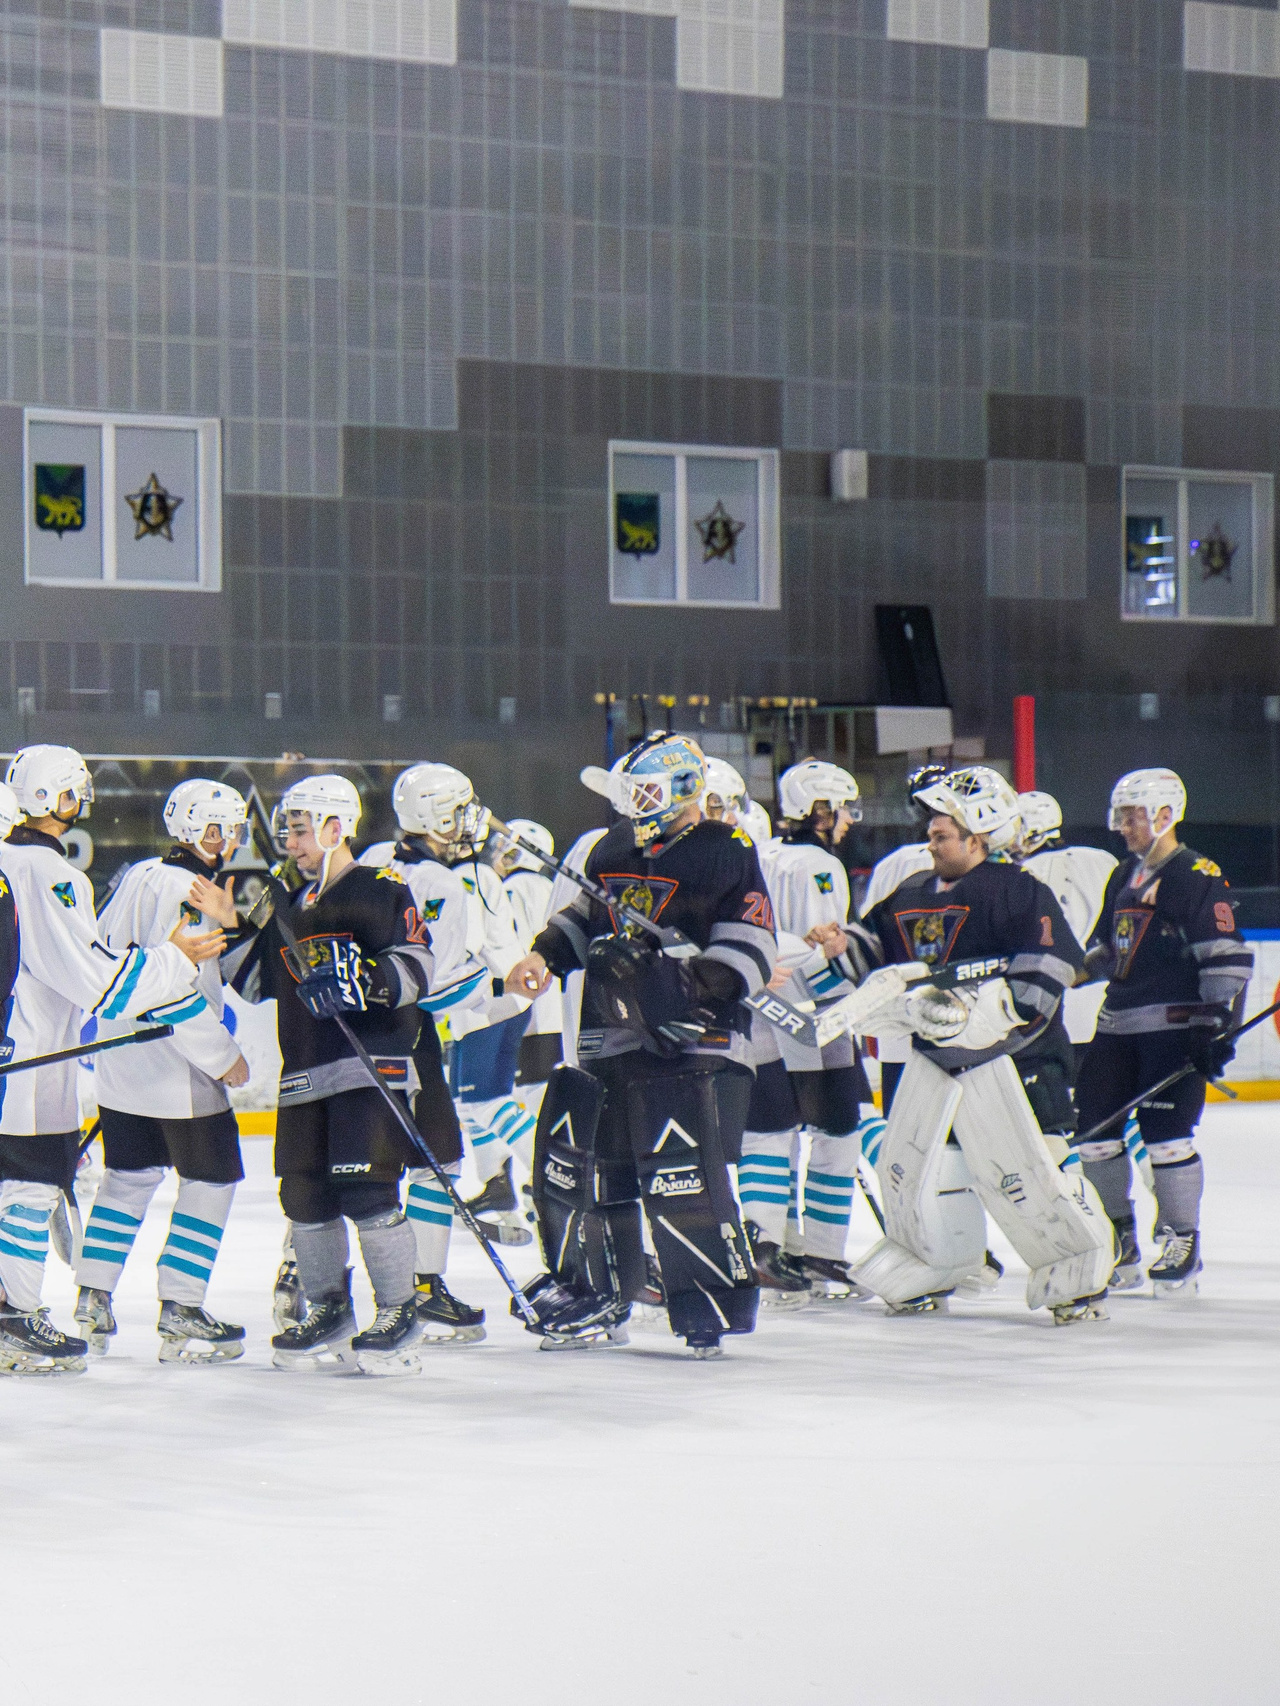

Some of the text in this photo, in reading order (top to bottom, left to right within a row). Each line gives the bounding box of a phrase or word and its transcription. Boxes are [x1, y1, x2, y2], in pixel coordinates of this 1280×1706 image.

[1039, 915, 1055, 947] 1
[1213, 901, 1236, 933] 9
[331, 1163, 372, 1174] CCM
